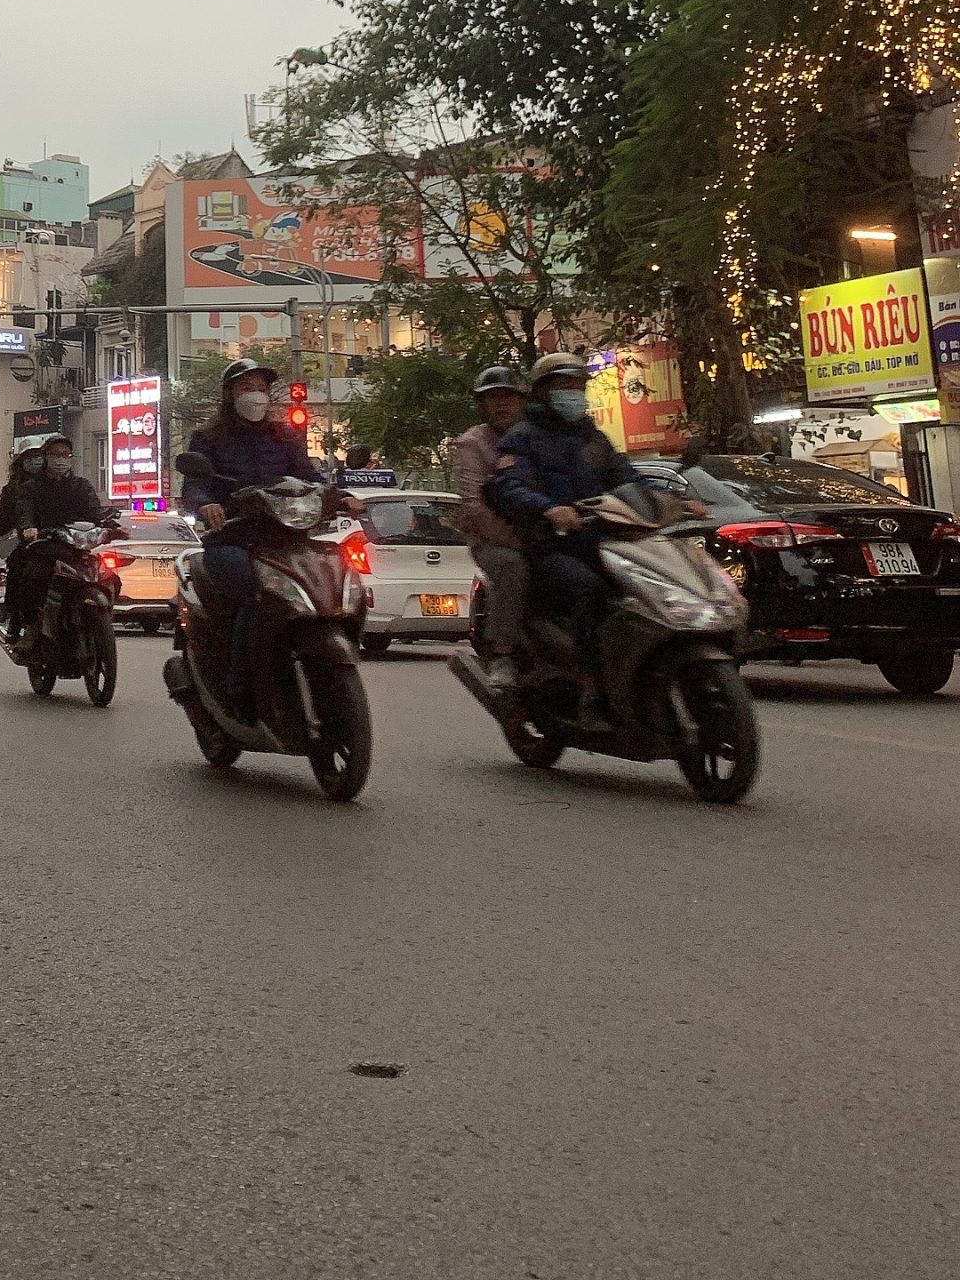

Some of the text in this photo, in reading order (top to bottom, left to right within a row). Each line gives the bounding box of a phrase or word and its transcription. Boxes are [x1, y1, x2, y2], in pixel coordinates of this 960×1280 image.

[806, 283, 921, 358] BÚN RIÊU
[879, 543, 904, 558] 98A
